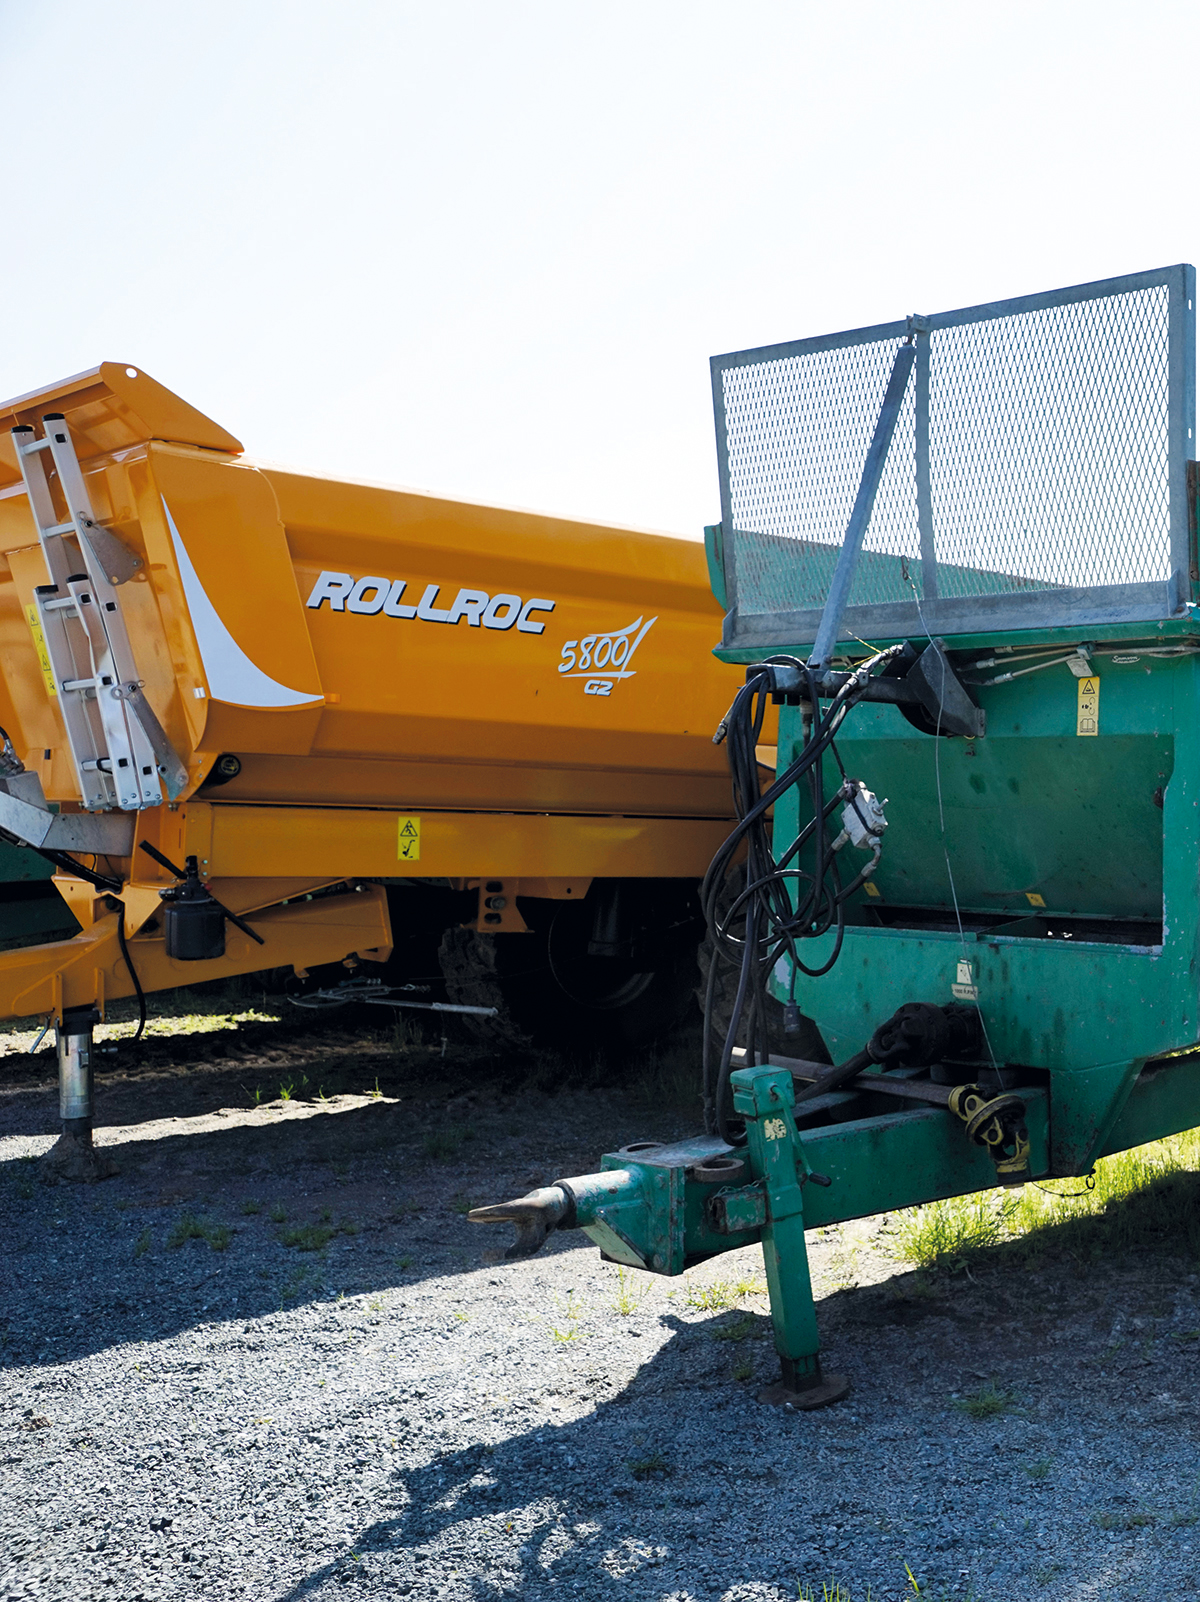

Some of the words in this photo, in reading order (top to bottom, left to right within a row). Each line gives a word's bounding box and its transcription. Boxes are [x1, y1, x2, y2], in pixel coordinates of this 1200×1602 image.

[306, 570, 556, 635] ROLLROC
[558, 635, 629, 673] 5800
[584, 679, 614, 696] G2
